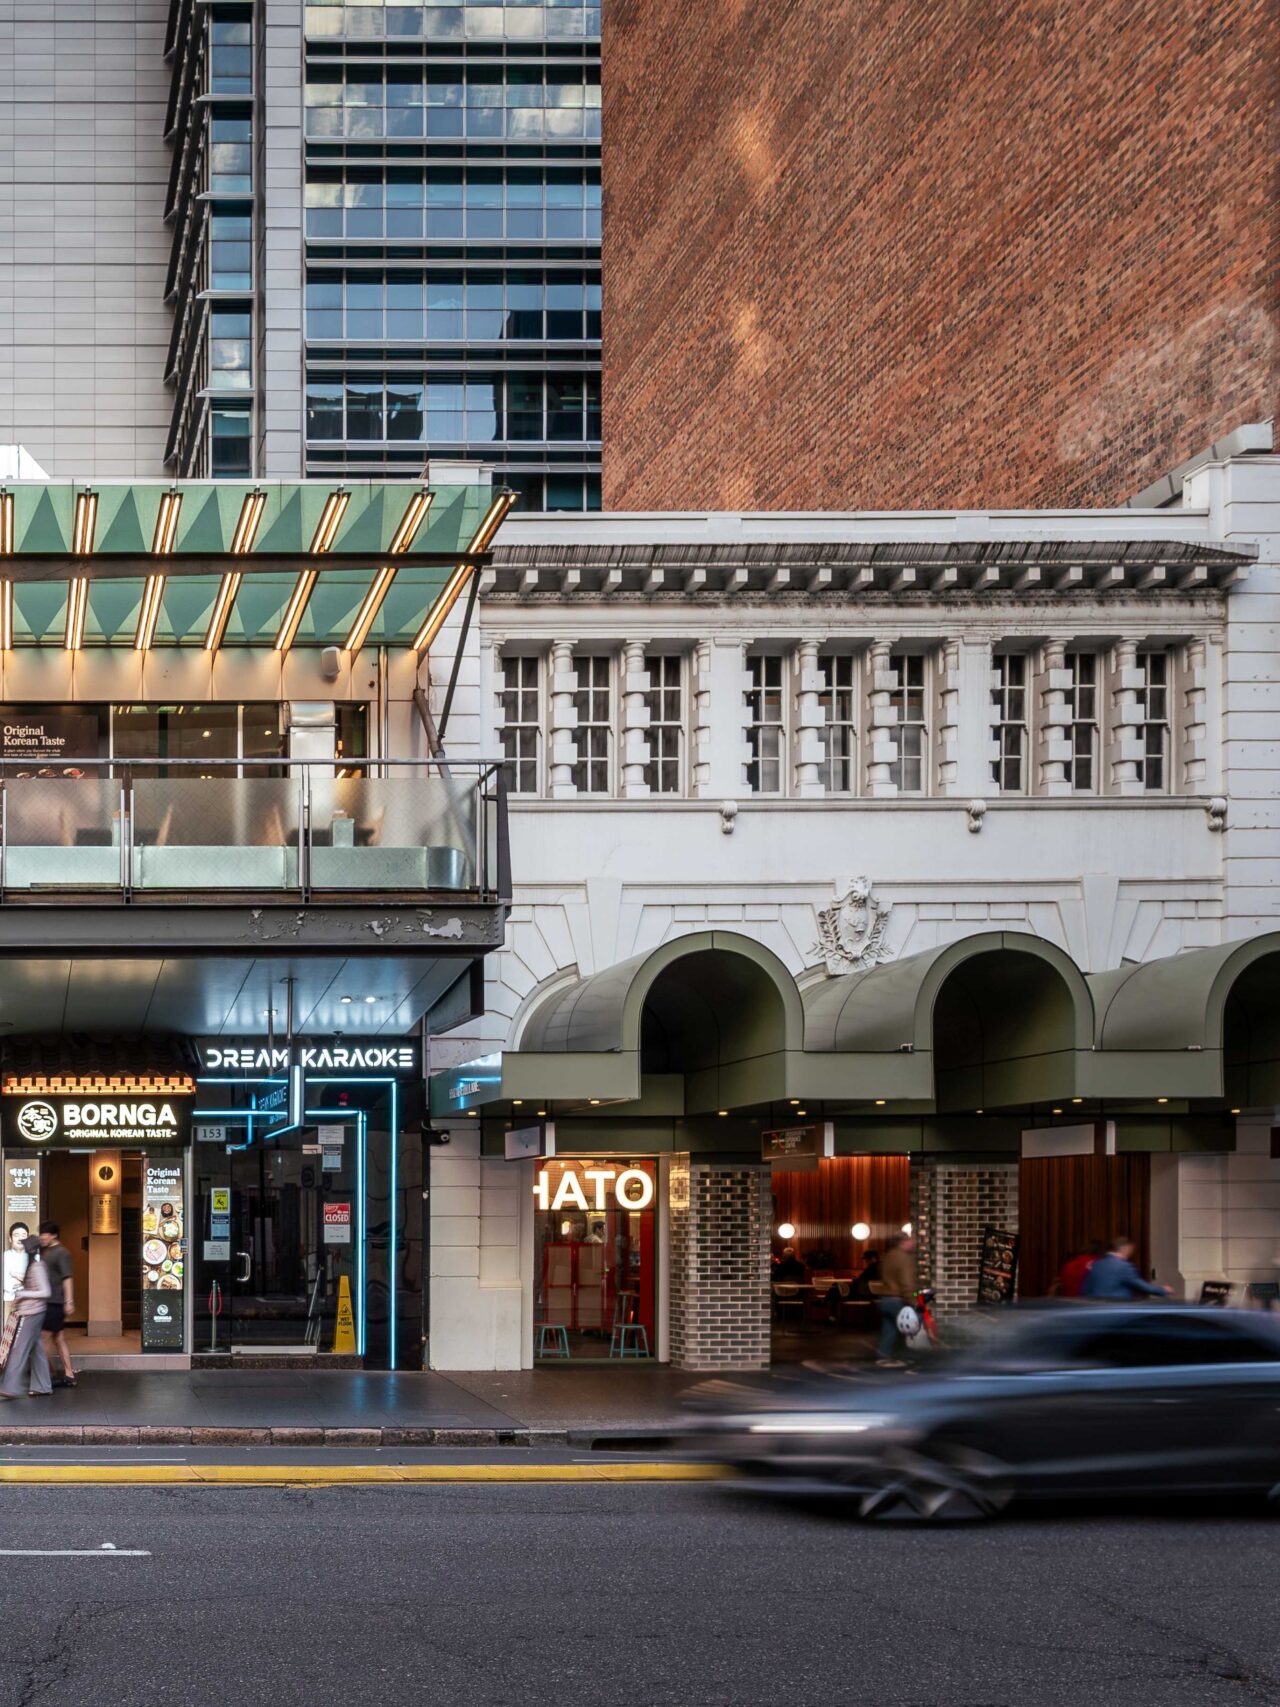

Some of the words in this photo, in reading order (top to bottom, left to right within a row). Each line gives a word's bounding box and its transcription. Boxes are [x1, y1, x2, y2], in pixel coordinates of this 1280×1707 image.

[3, 725, 44, 738] Original
[3, 735, 39, 746] Korean
[40, 735, 66, 746] Taste
[206, 1048, 289, 1068] DREAM
[300, 1048, 414, 1068] KARAOKE
[63, 1103, 177, 1126] BORNGA
[110, 1128, 145, 1138] KOREAN
[202, 1128, 222, 1138] 153
[146, 1167, 181, 1178] Original
[146, 1176, 177, 1185] Korean
[146, 1185, 170, 1194] Taste
[325, 1213, 349, 1222] CLOSED
